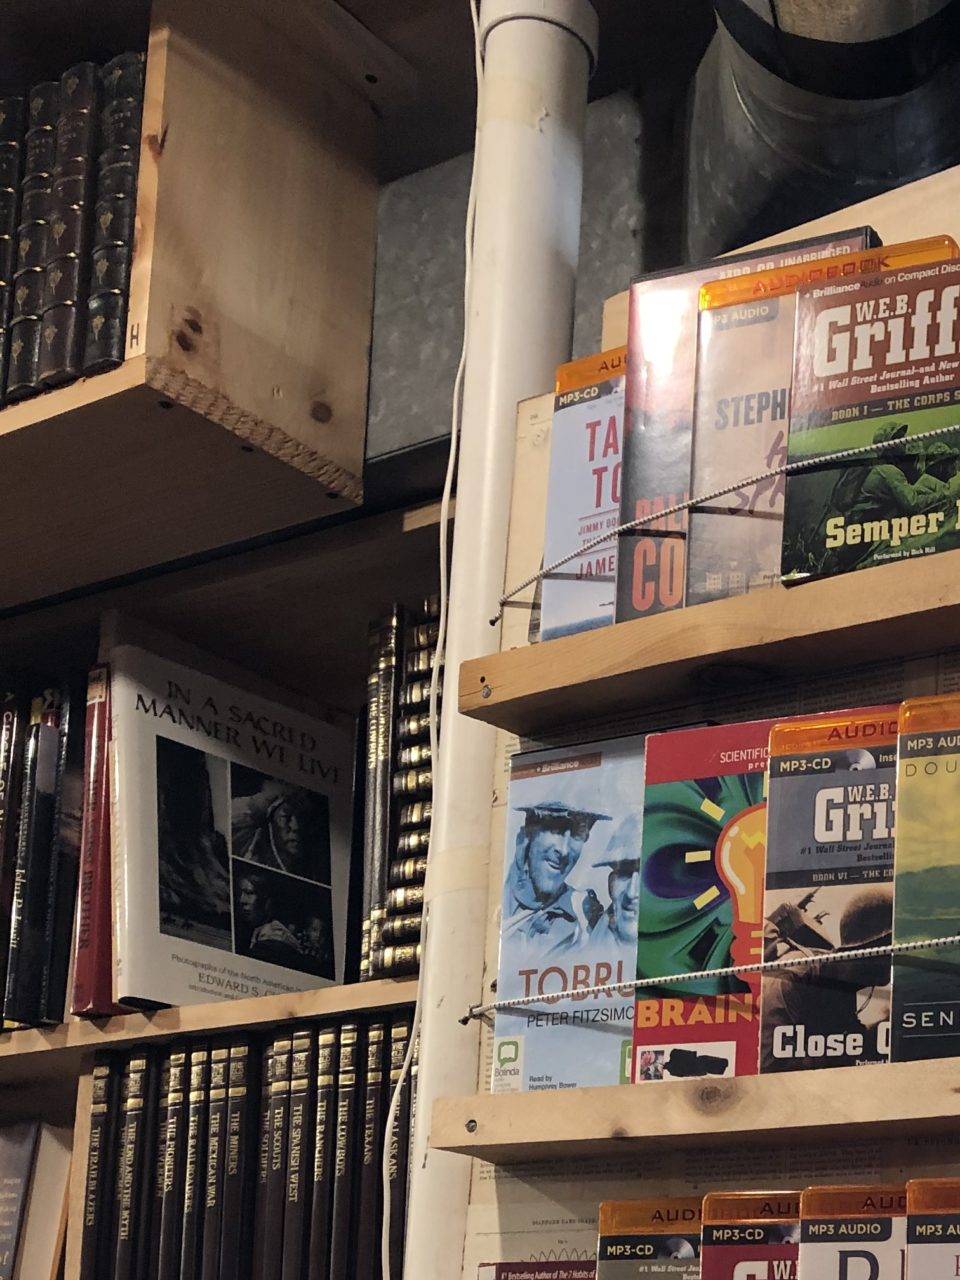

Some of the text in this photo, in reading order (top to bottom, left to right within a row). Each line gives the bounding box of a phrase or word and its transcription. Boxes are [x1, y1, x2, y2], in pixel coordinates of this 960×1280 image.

[897, 267, 939, 283] Compact
[856, 295, 912, 323] W.E.B.
[559, 387, 599, 406] MP3-CD
[887, 398, 911, 411] THE
[914, 393, 951, 407] CORPS
[825, 507, 944, 549] Semper
[135, 693, 241, 748] MANNER
[907, 736, 935, 751] MP3
[779, 757, 832, 773] MP3-CD
[198, 972, 249, 994] EDWARD
[527, 1010, 569, 1028] PETER
[772, 1023, 864, 1059] Close
[712, 1228, 764, 1241] MP3-CD
[808, 1222, 881, 1236] MP3 AUDIO
[915, 1224, 943, 1237] MP3
[607, 1244, 654, 1256] MP3-CD
